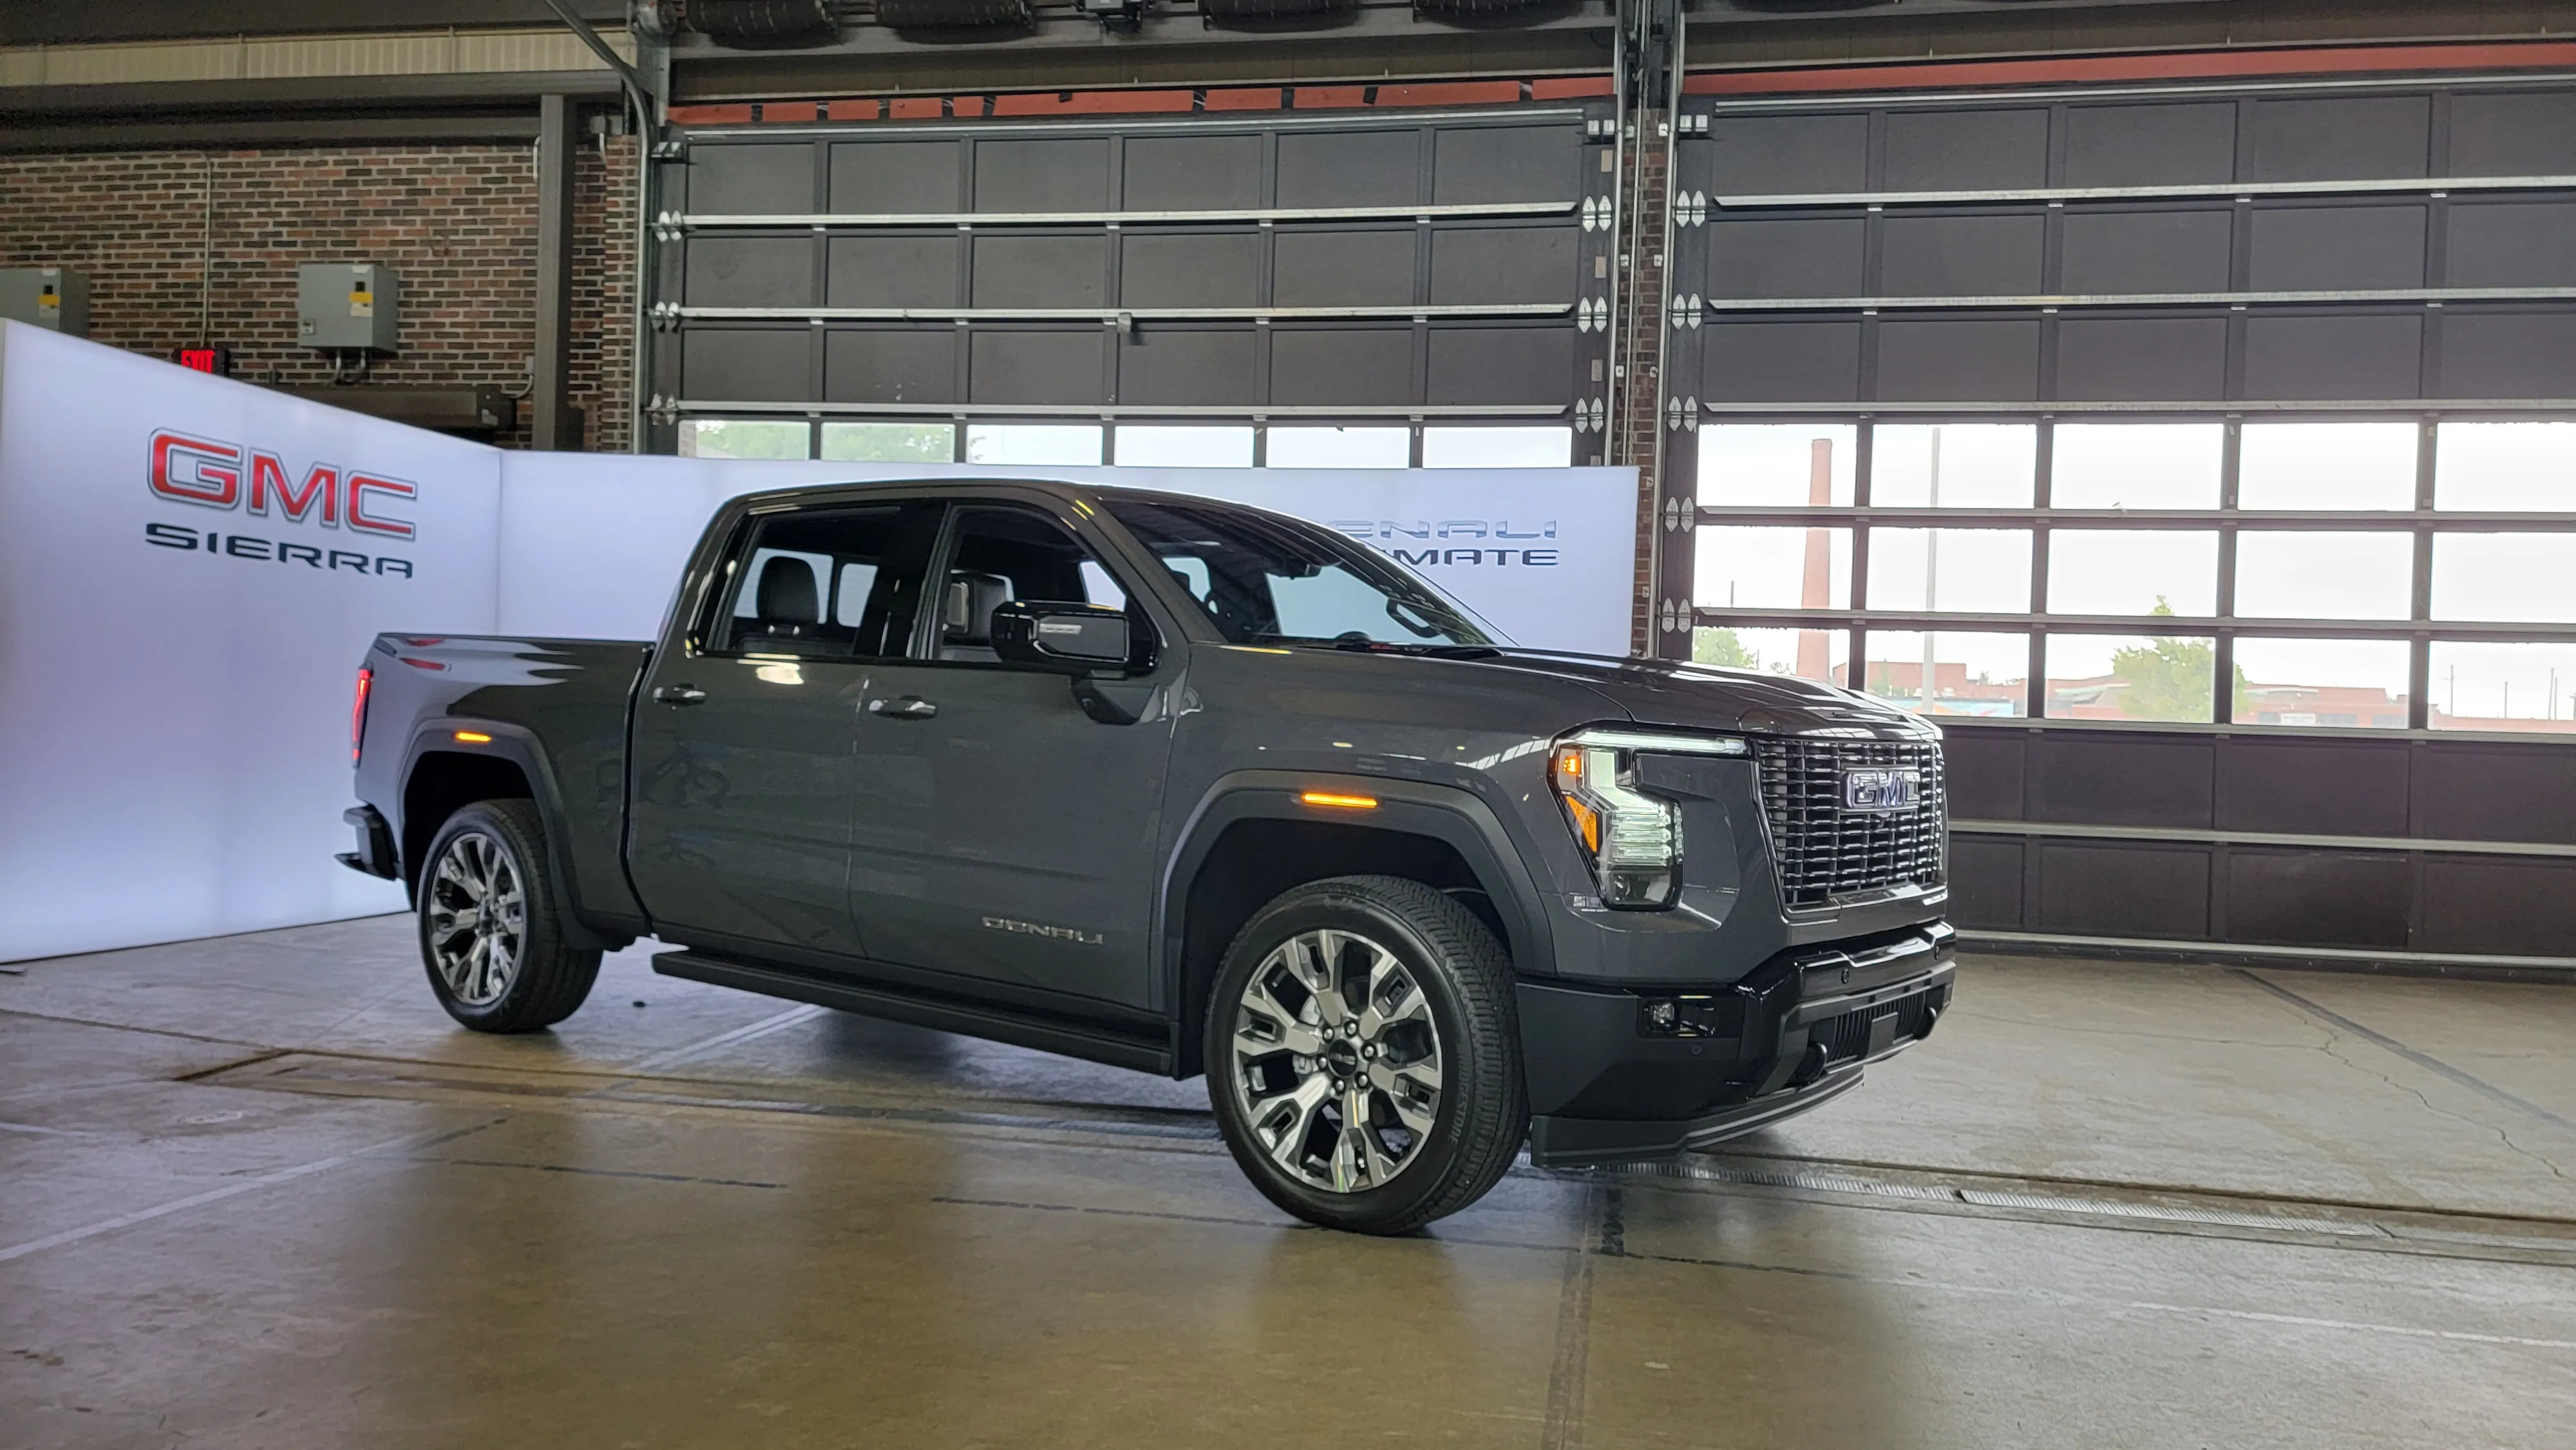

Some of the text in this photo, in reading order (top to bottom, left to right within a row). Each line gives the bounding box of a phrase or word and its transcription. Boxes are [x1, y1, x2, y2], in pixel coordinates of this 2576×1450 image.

[181, 350, 215, 374] EXIT
[147, 428, 417, 541] GMC
[1328, 520, 1557, 539] ENALI
[146, 522, 413, 579] SIERRA
[1391, 549, 1559, 566] MATE
[1846, 771, 1920, 808] GMC
[981, 916, 1103, 945] DENALI
